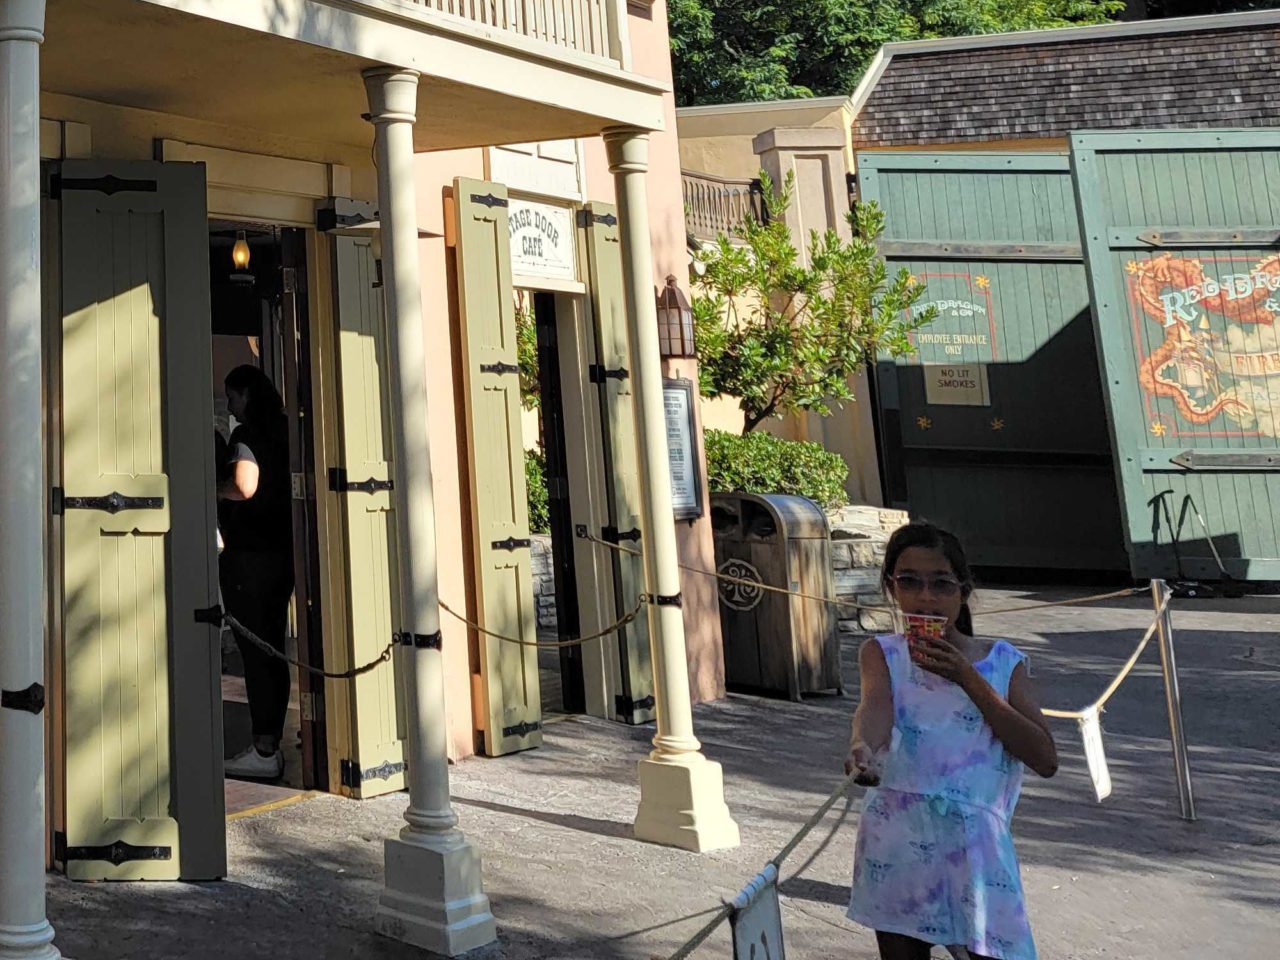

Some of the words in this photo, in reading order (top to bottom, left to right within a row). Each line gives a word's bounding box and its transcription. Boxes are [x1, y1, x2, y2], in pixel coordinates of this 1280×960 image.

[508, 209, 532, 239] TAGE
[535, 210, 559, 249] DOOR
[936, 299, 986, 317] DRAGON
[1159, 277, 1220, 328] RED
[918, 333, 951, 344] EMPLOYEE
[953, 334, 987, 345] ENTRANCE
[945, 345, 962, 355] ONLY
[941, 369, 955, 378] NO
[957, 369, 969, 378] LIT
[937, 379, 976, 389] SMOKES
